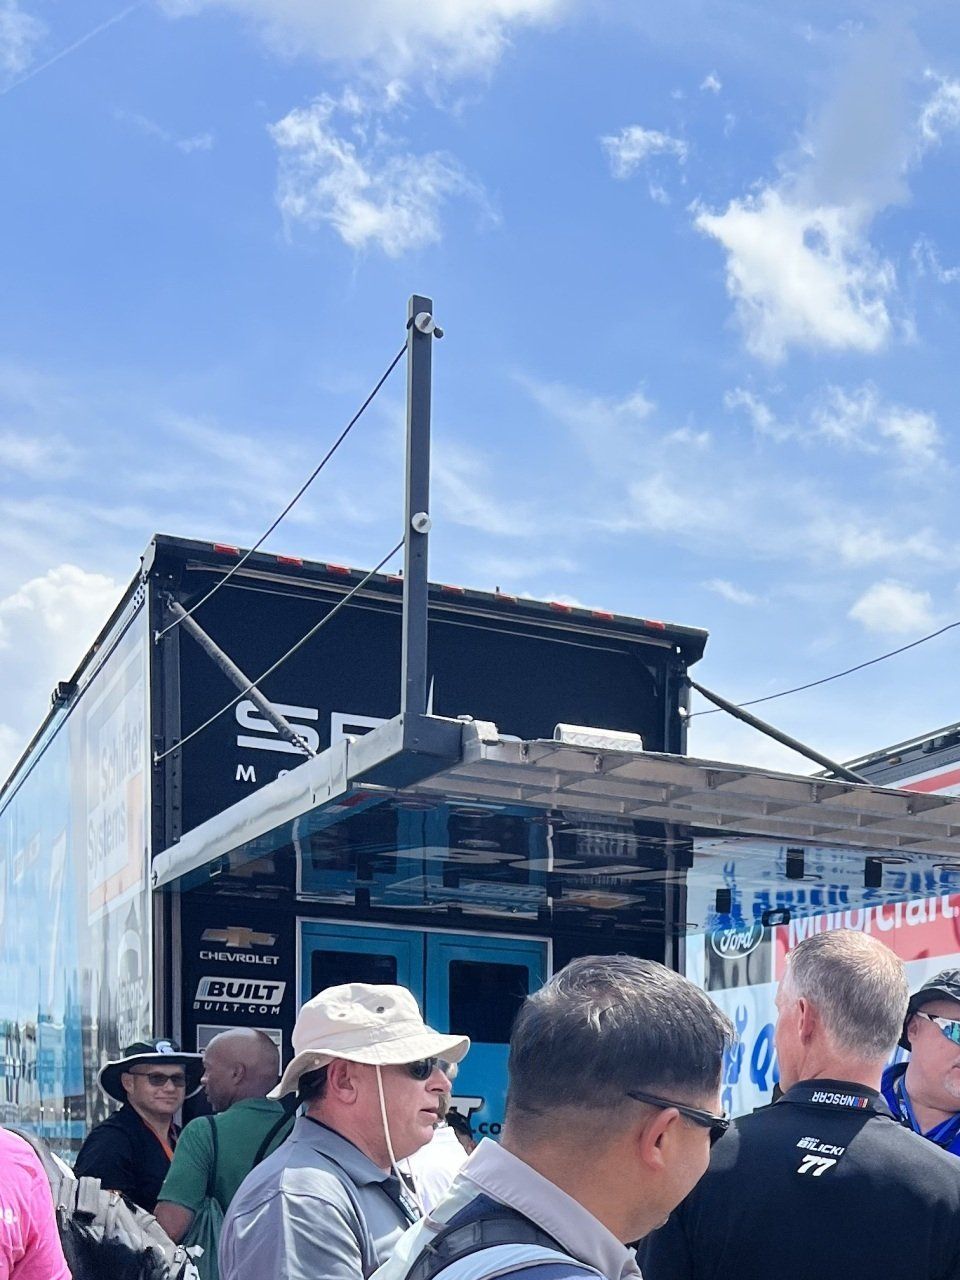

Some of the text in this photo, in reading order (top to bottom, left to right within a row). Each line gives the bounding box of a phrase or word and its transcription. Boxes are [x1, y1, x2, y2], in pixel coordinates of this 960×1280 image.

[719, 926, 756, 951] Ford
[199, 950, 280, 965] CHEVROLET
[207, 980, 280, 1001] BUILT
[193, 1001, 281, 1015] BUILT.COM
[811, 1091, 856, 1107] NASCAR
[796, 1139, 845, 1156] BILICKI
[797, 1154, 837, 1177] 77
